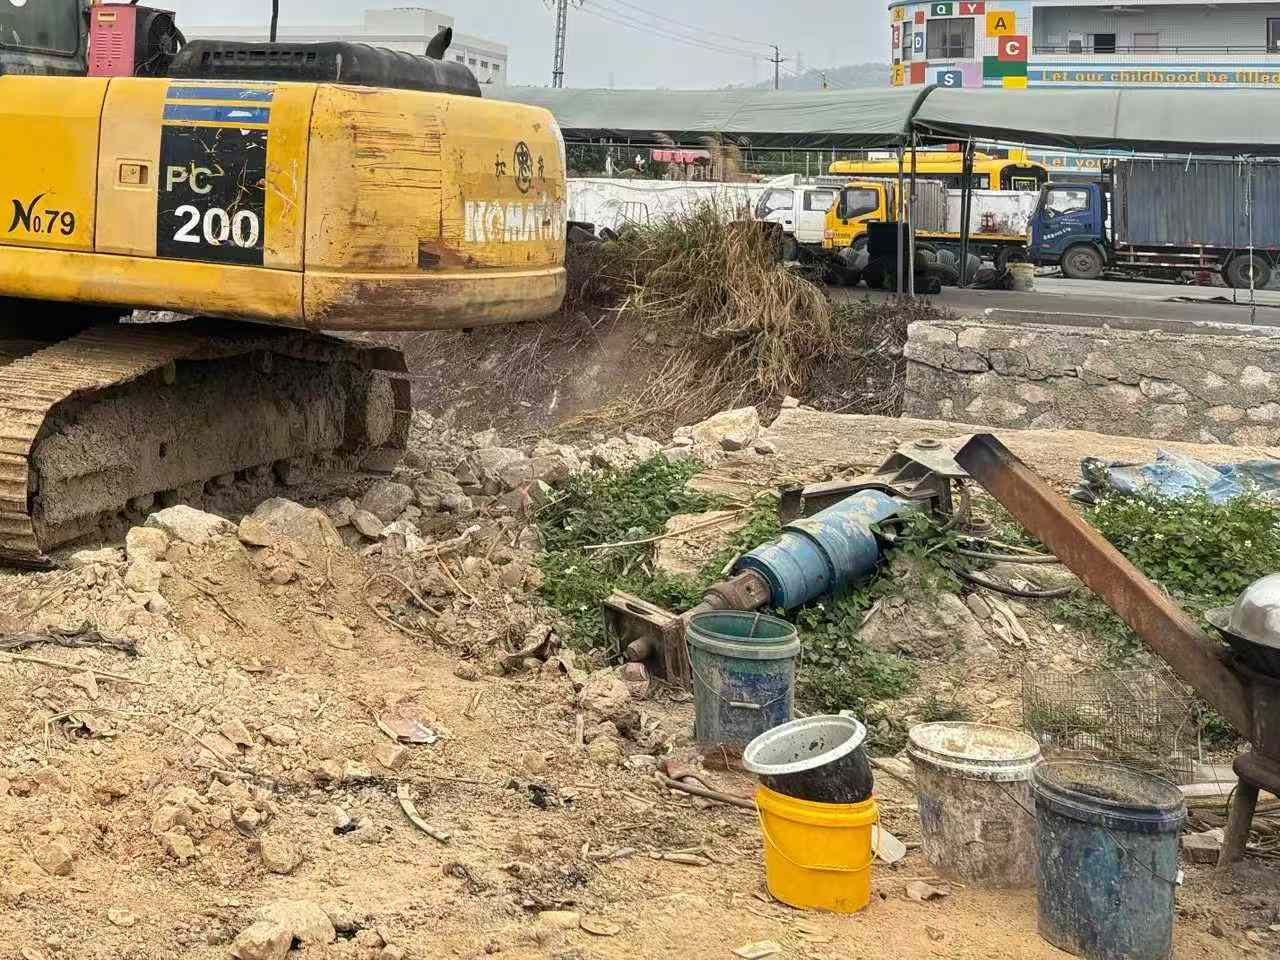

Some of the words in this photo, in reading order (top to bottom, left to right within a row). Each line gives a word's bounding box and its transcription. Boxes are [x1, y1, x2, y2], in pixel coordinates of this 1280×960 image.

[936, 5, 946, 15] Q
[967, 3, 977, 14] Y
[994, 16, 1007, 30] A
[1004, 41, 1020, 55] C
[943, 73, 954, 86] S
[1042, 67, 1069, 81] Let
[1075, 72, 1104, 81] our
[1110, 69, 1200, 83] childhood
[166, 166, 213, 194] PC
[173, 204, 260, 248] 200
